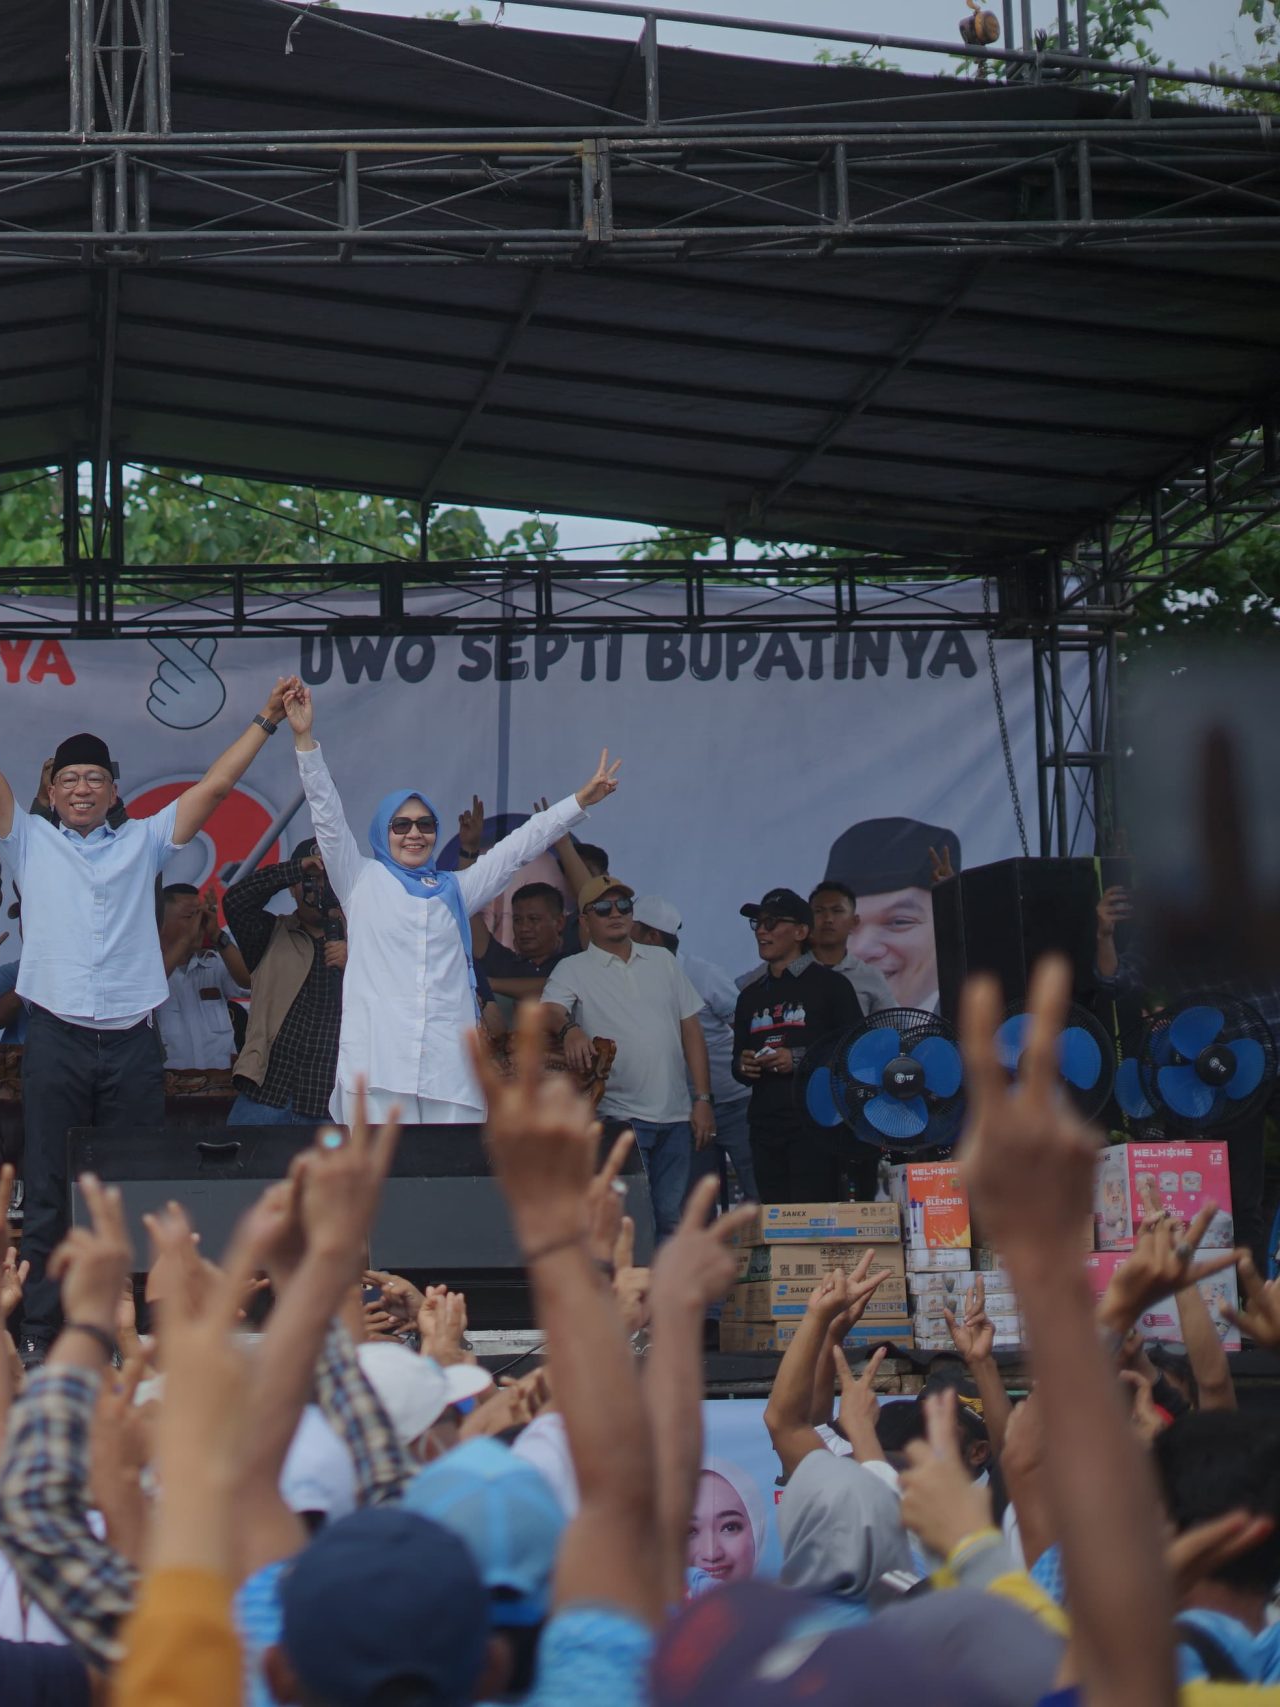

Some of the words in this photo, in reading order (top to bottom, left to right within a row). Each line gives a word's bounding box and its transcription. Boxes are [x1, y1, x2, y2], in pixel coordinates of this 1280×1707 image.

[300, 628, 436, 685] UWO
[458, 628, 623, 683] SEPTI
[645, 628, 978, 682] BUPATINYA
[925, 1197, 963, 1207] BLENDER
